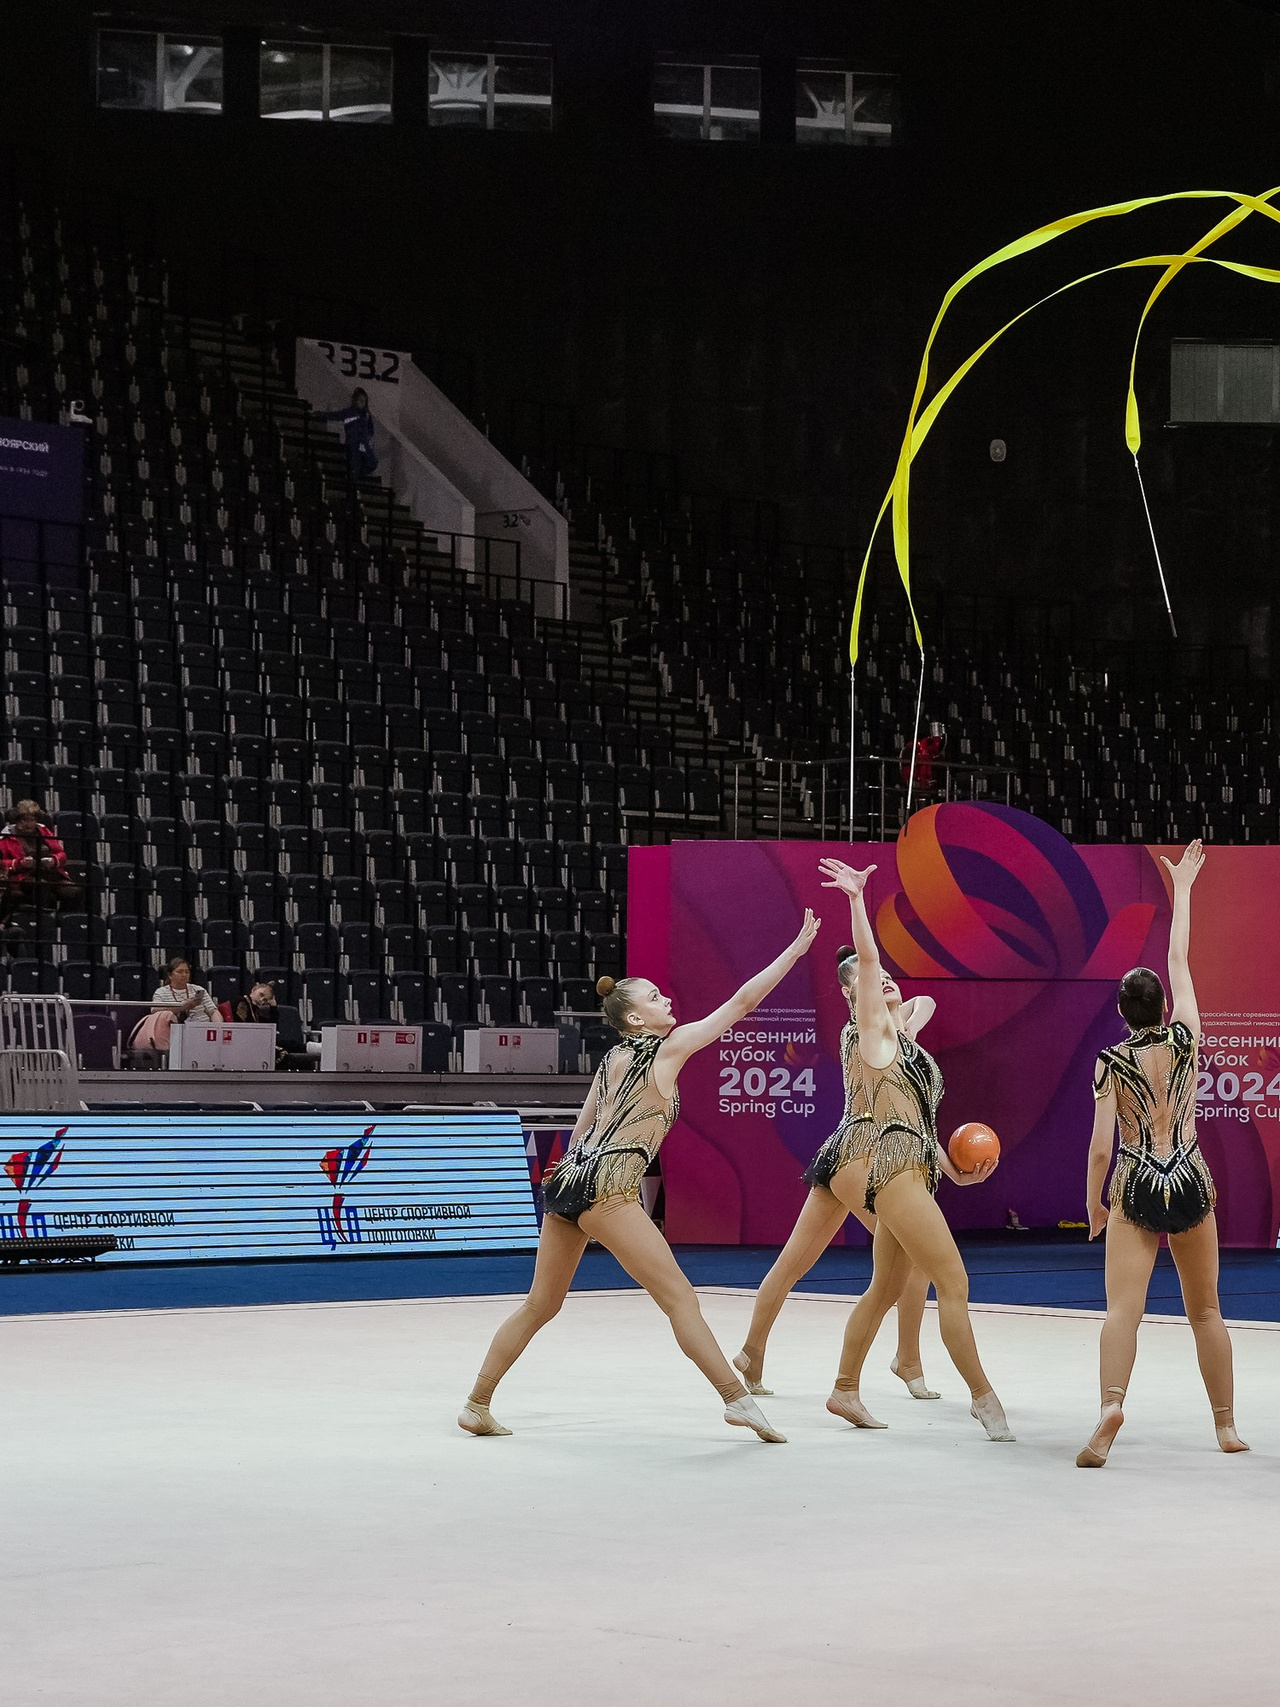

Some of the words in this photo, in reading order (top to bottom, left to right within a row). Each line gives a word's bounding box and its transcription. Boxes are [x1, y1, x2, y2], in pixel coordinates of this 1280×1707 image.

[720, 1027, 816, 1044] Весенний
[719, 1046, 776, 1066] кубок
[719, 1066, 816, 1097] 2024
[719, 1098, 776, 1118] Spring
[781, 1099, 815, 1117] Cup
[1195, 1104, 1250, 1122] Spring
[53, 1213, 92, 1231] ЦЕНТР
[364, 1207, 398, 1224] ЦЕНТР
